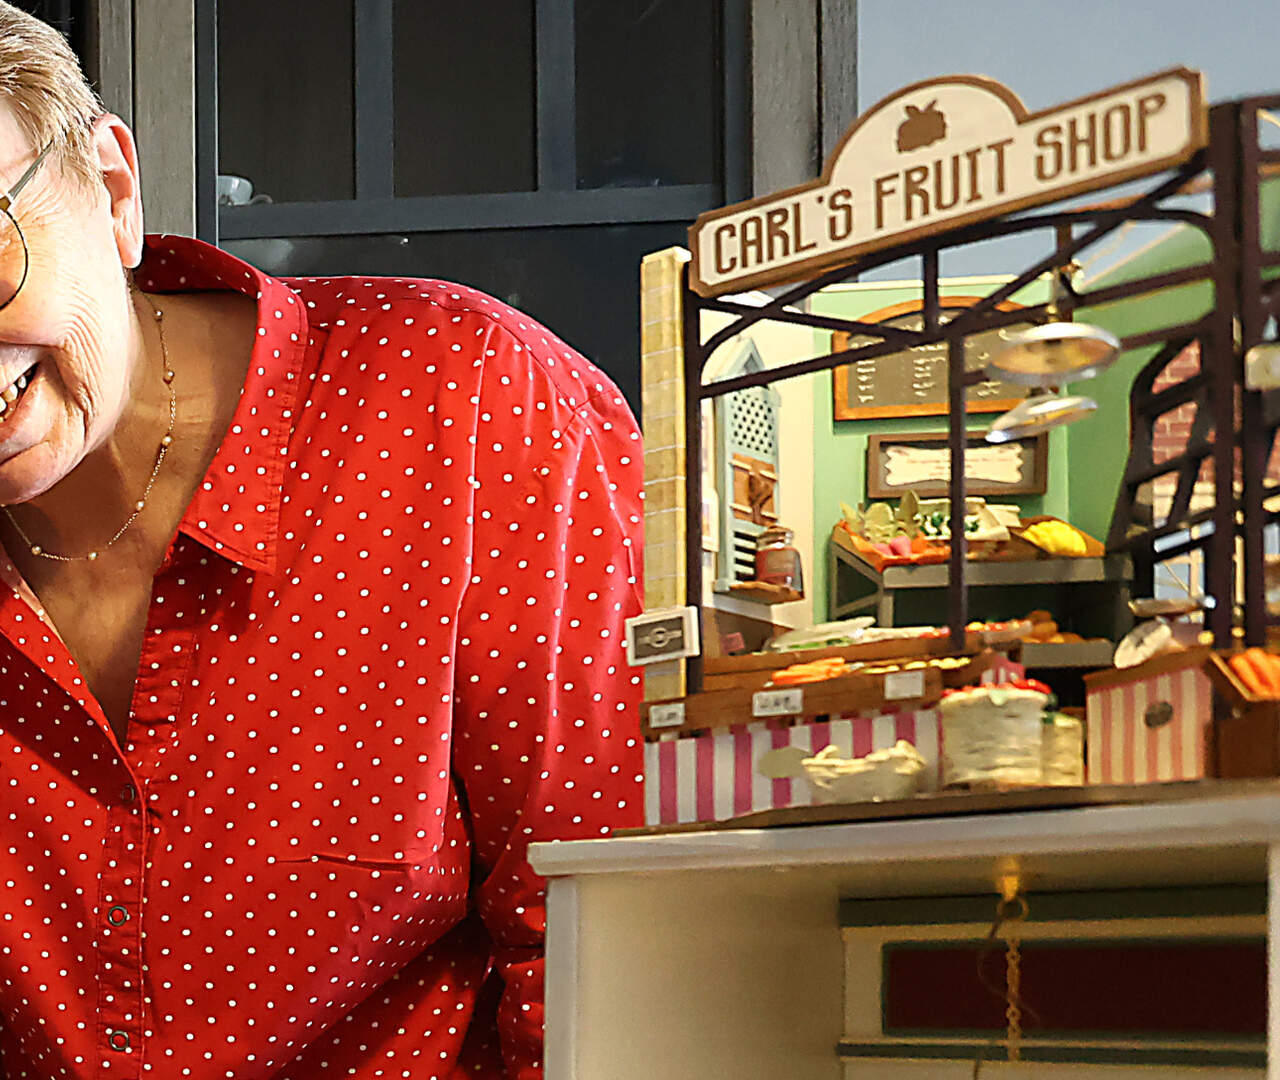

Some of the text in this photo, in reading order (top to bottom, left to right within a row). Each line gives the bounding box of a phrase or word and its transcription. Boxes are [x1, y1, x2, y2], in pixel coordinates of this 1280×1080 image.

[714, 93, 1167, 275] CARL'S FRUIT SHOP
